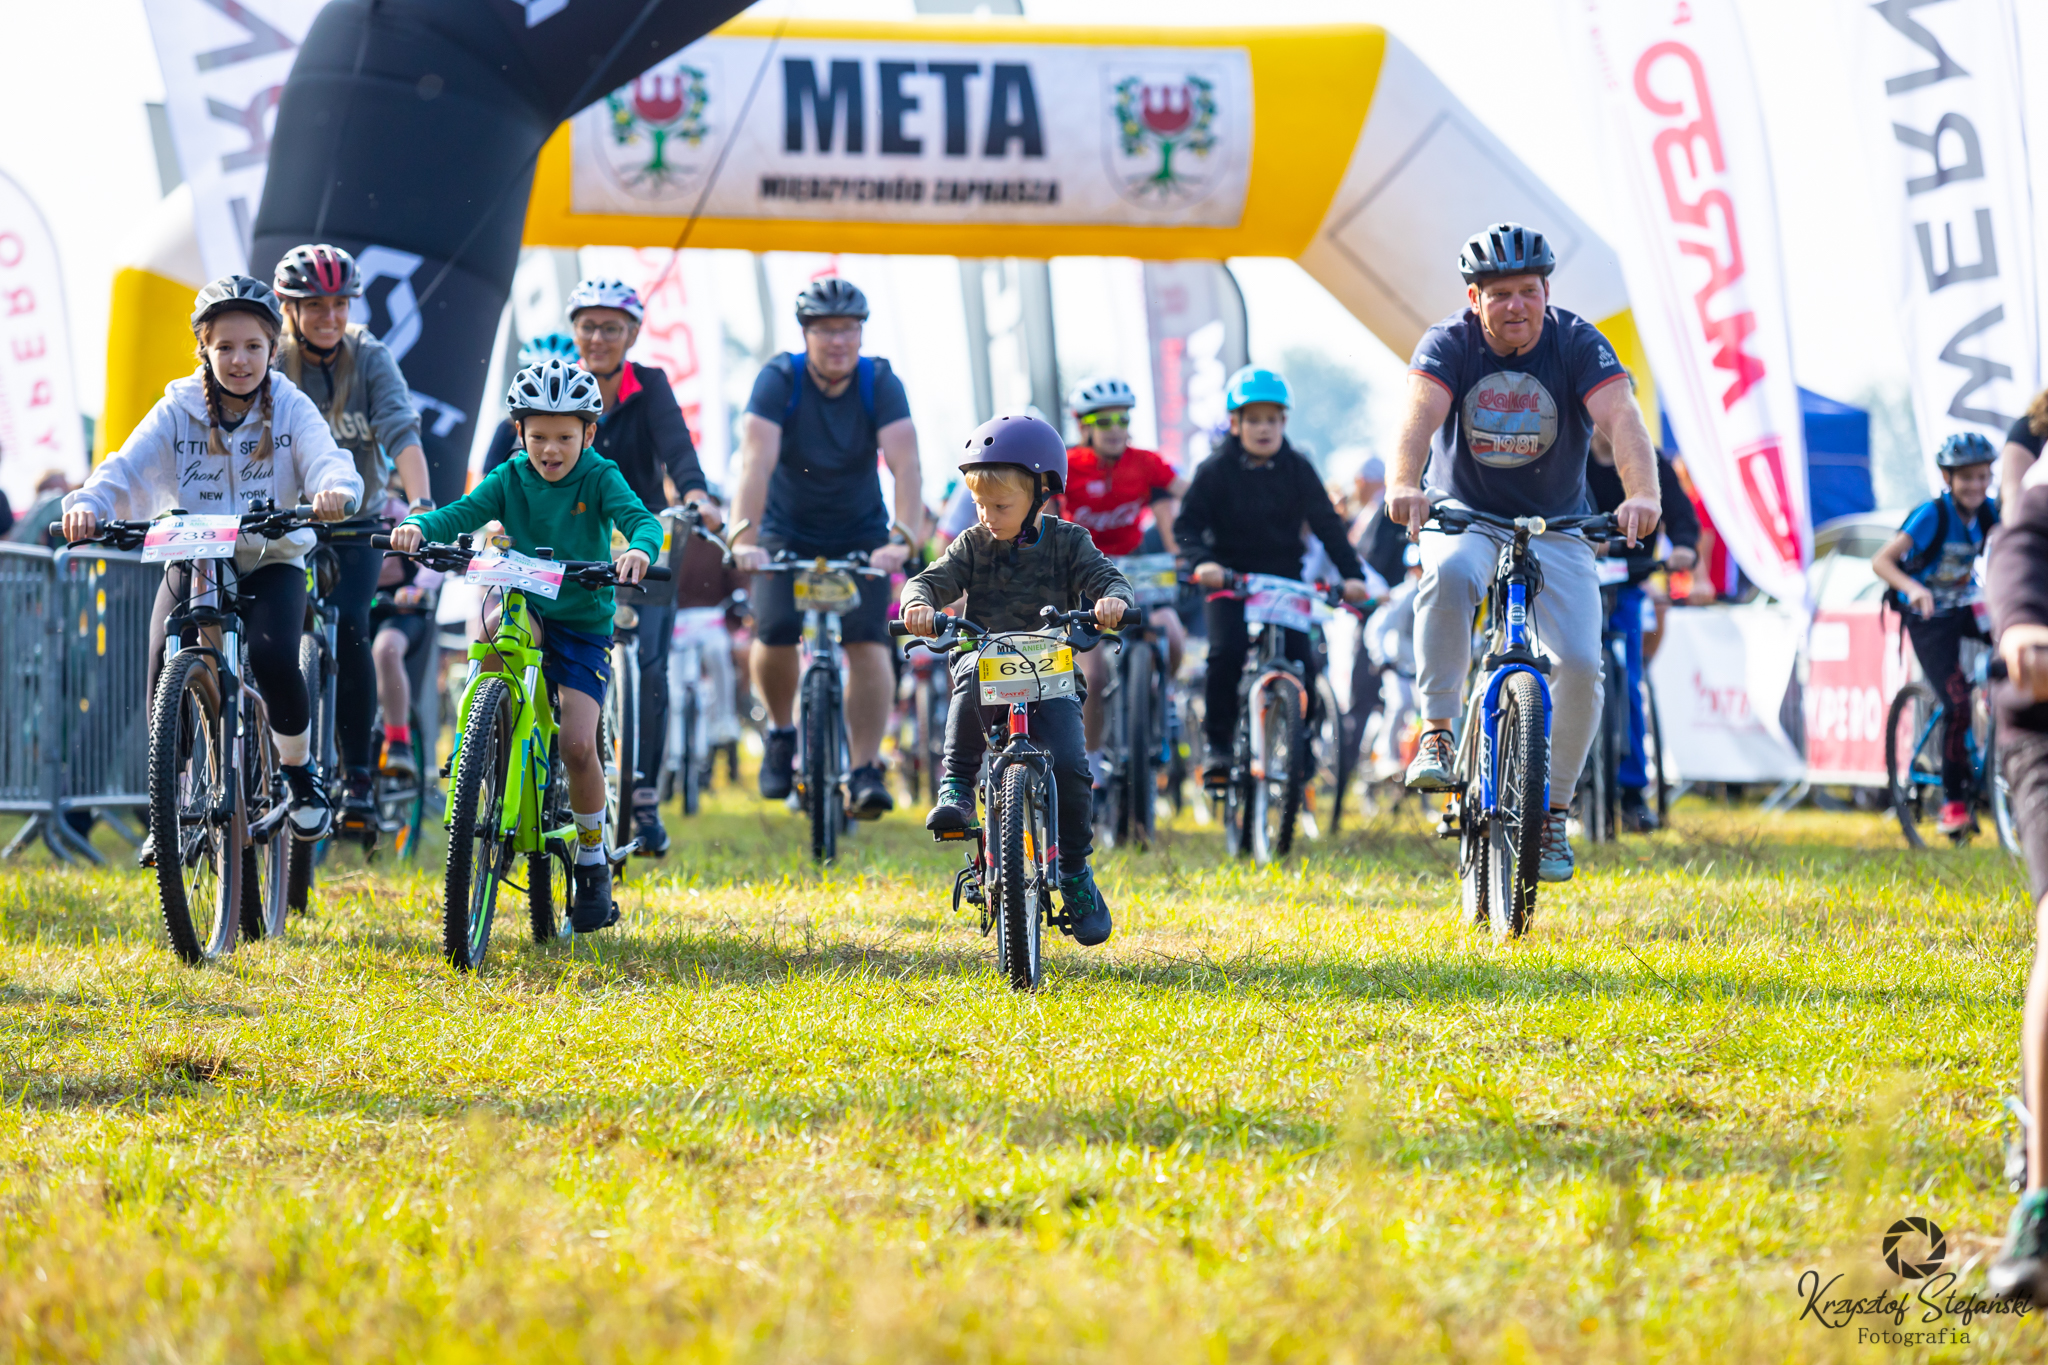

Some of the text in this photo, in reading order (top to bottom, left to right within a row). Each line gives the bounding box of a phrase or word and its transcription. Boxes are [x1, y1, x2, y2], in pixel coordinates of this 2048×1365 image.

[782, 58, 1045, 157] META
[1478, 388, 1540, 410] dakar
[200, 489, 267, 500] NEW YORK
[166, 530, 216, 541] 738
[1021, 643, 1047, 652] ANIELI
[1000, 658, 1054, 675] 692
